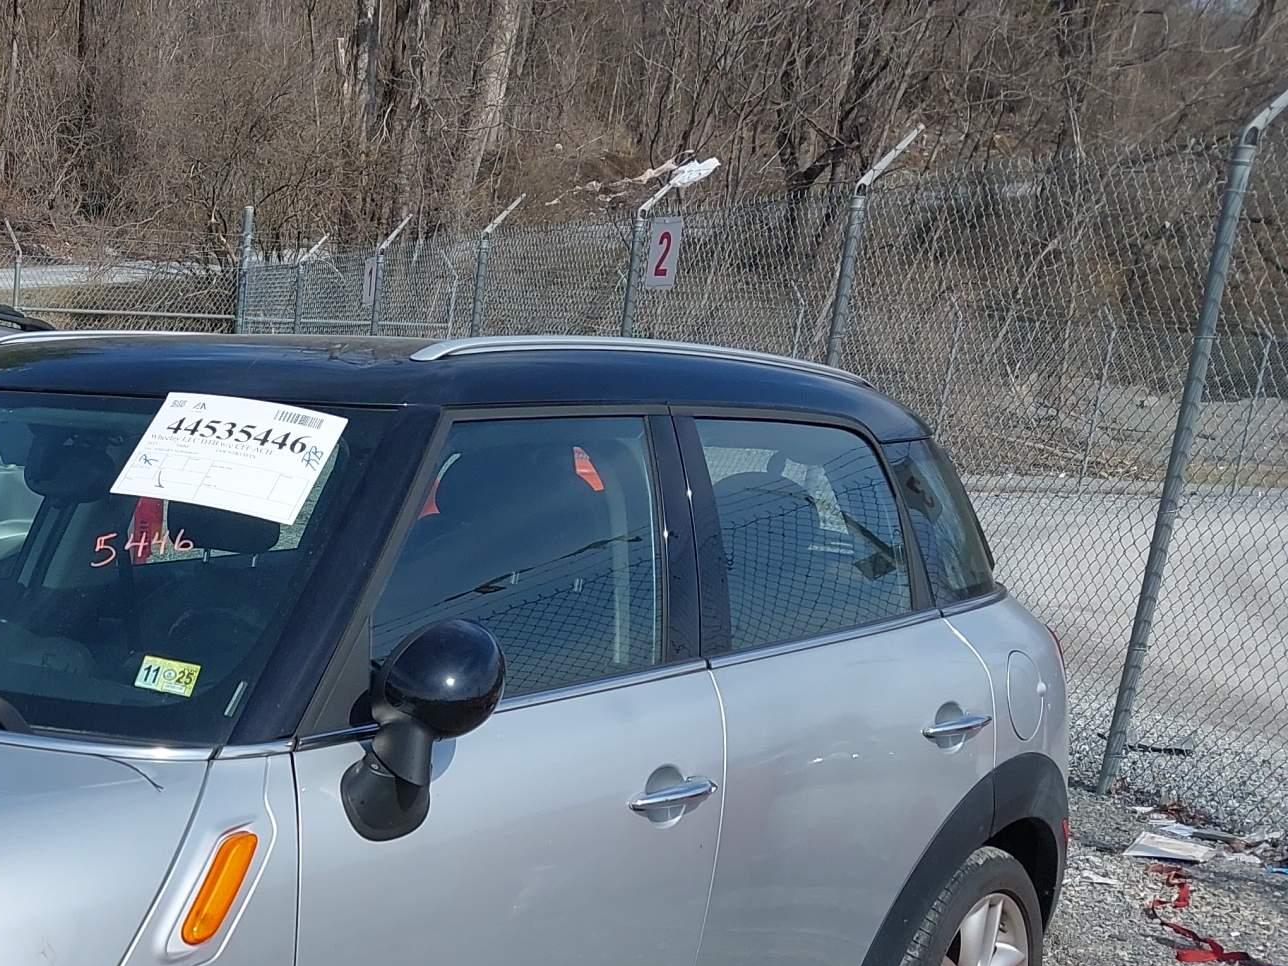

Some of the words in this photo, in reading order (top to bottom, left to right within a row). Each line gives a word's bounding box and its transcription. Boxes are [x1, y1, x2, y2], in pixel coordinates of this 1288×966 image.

[653, 231, 672, 277] 2
[166, 416, 313, 454] 44535446
[90, 528, 194, 567] 5446
[143, 664, 161, 684] 11
[175, 670, 195, 685] 25
